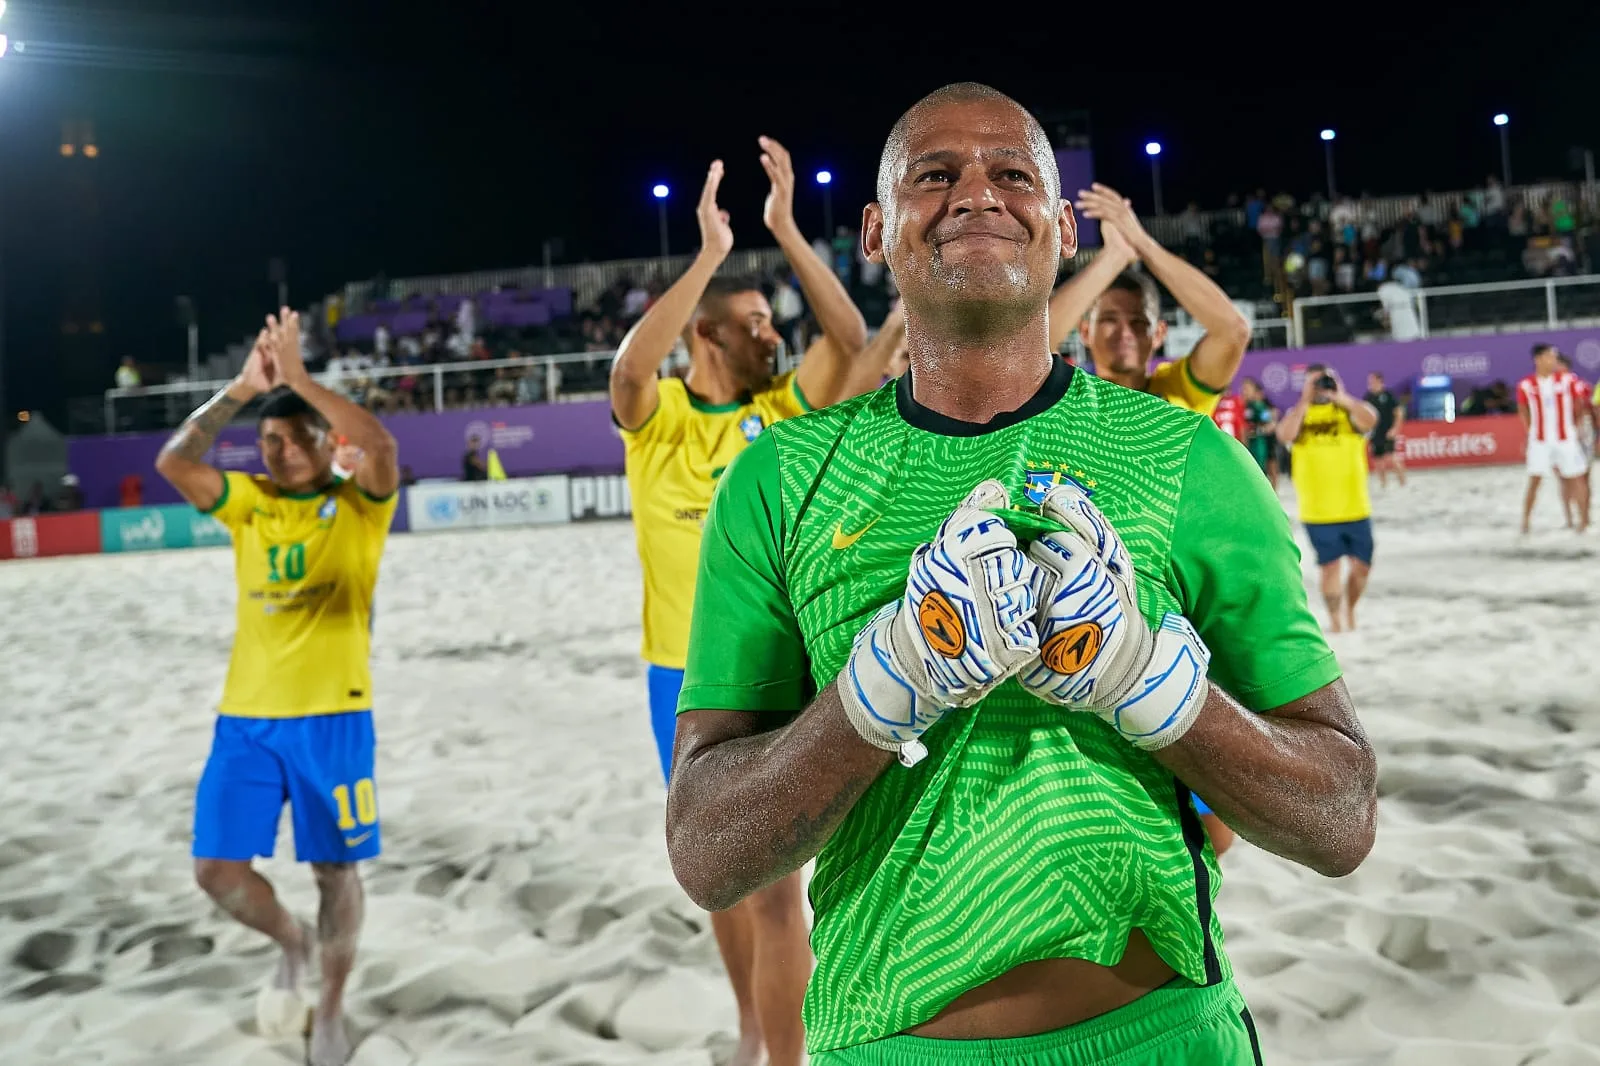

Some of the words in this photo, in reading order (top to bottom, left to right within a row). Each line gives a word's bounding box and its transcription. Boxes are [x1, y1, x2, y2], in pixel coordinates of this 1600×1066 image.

[1395, 431, 1497, 460] Emirates
[267, 543, 304, 582] 10
[332, 777, 378, 830] 10
